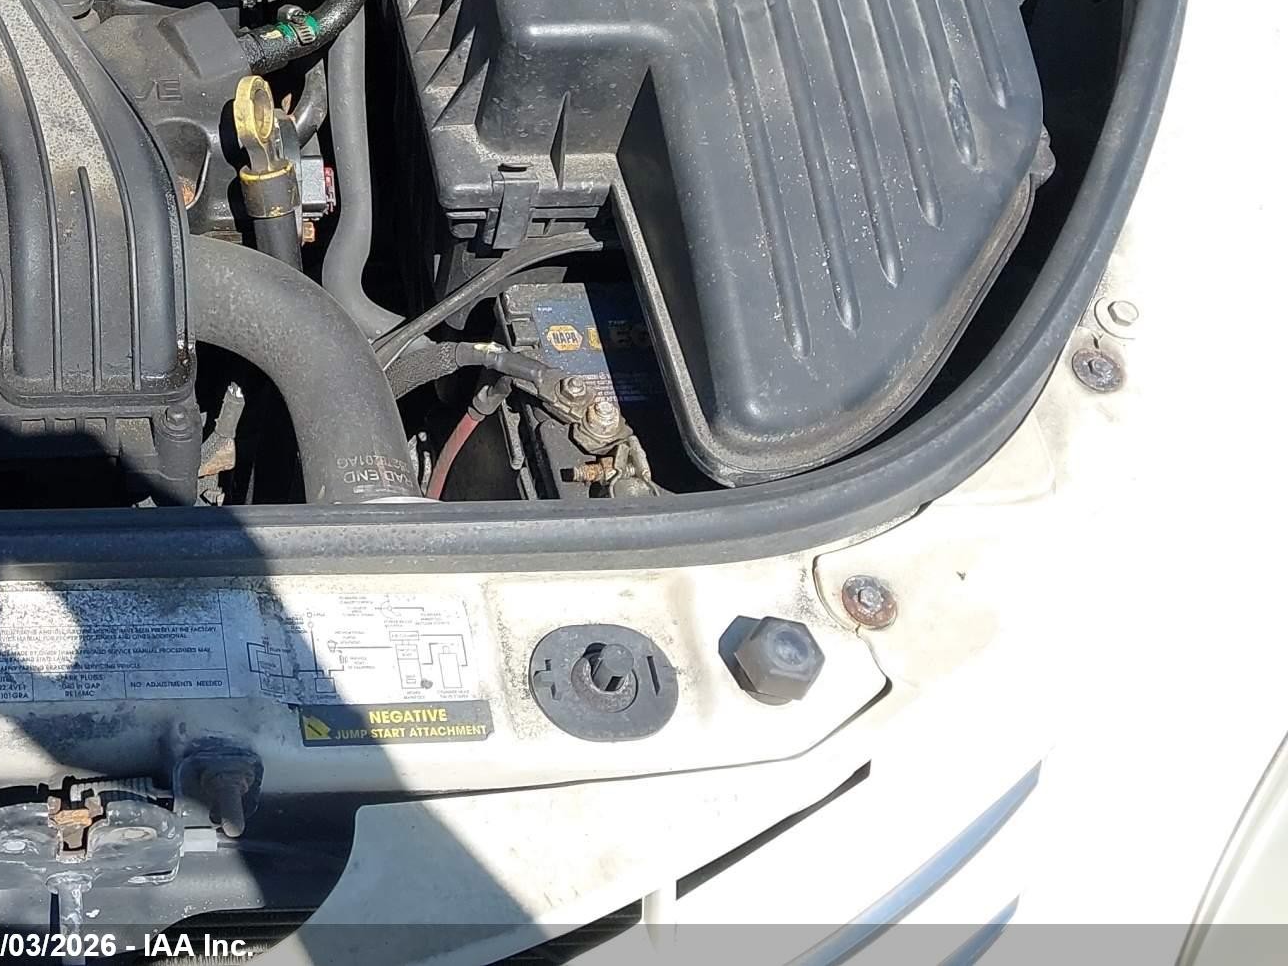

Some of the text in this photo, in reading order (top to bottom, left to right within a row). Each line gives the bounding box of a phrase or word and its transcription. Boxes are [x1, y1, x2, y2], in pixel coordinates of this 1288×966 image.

[551, 332, 579, 345] NAPA
[343, 469, 380, 484] END
[369, 708, 448, 724] NEGATIVE
[336, 724, 488, 740] JUMP START ATTACHMENT
